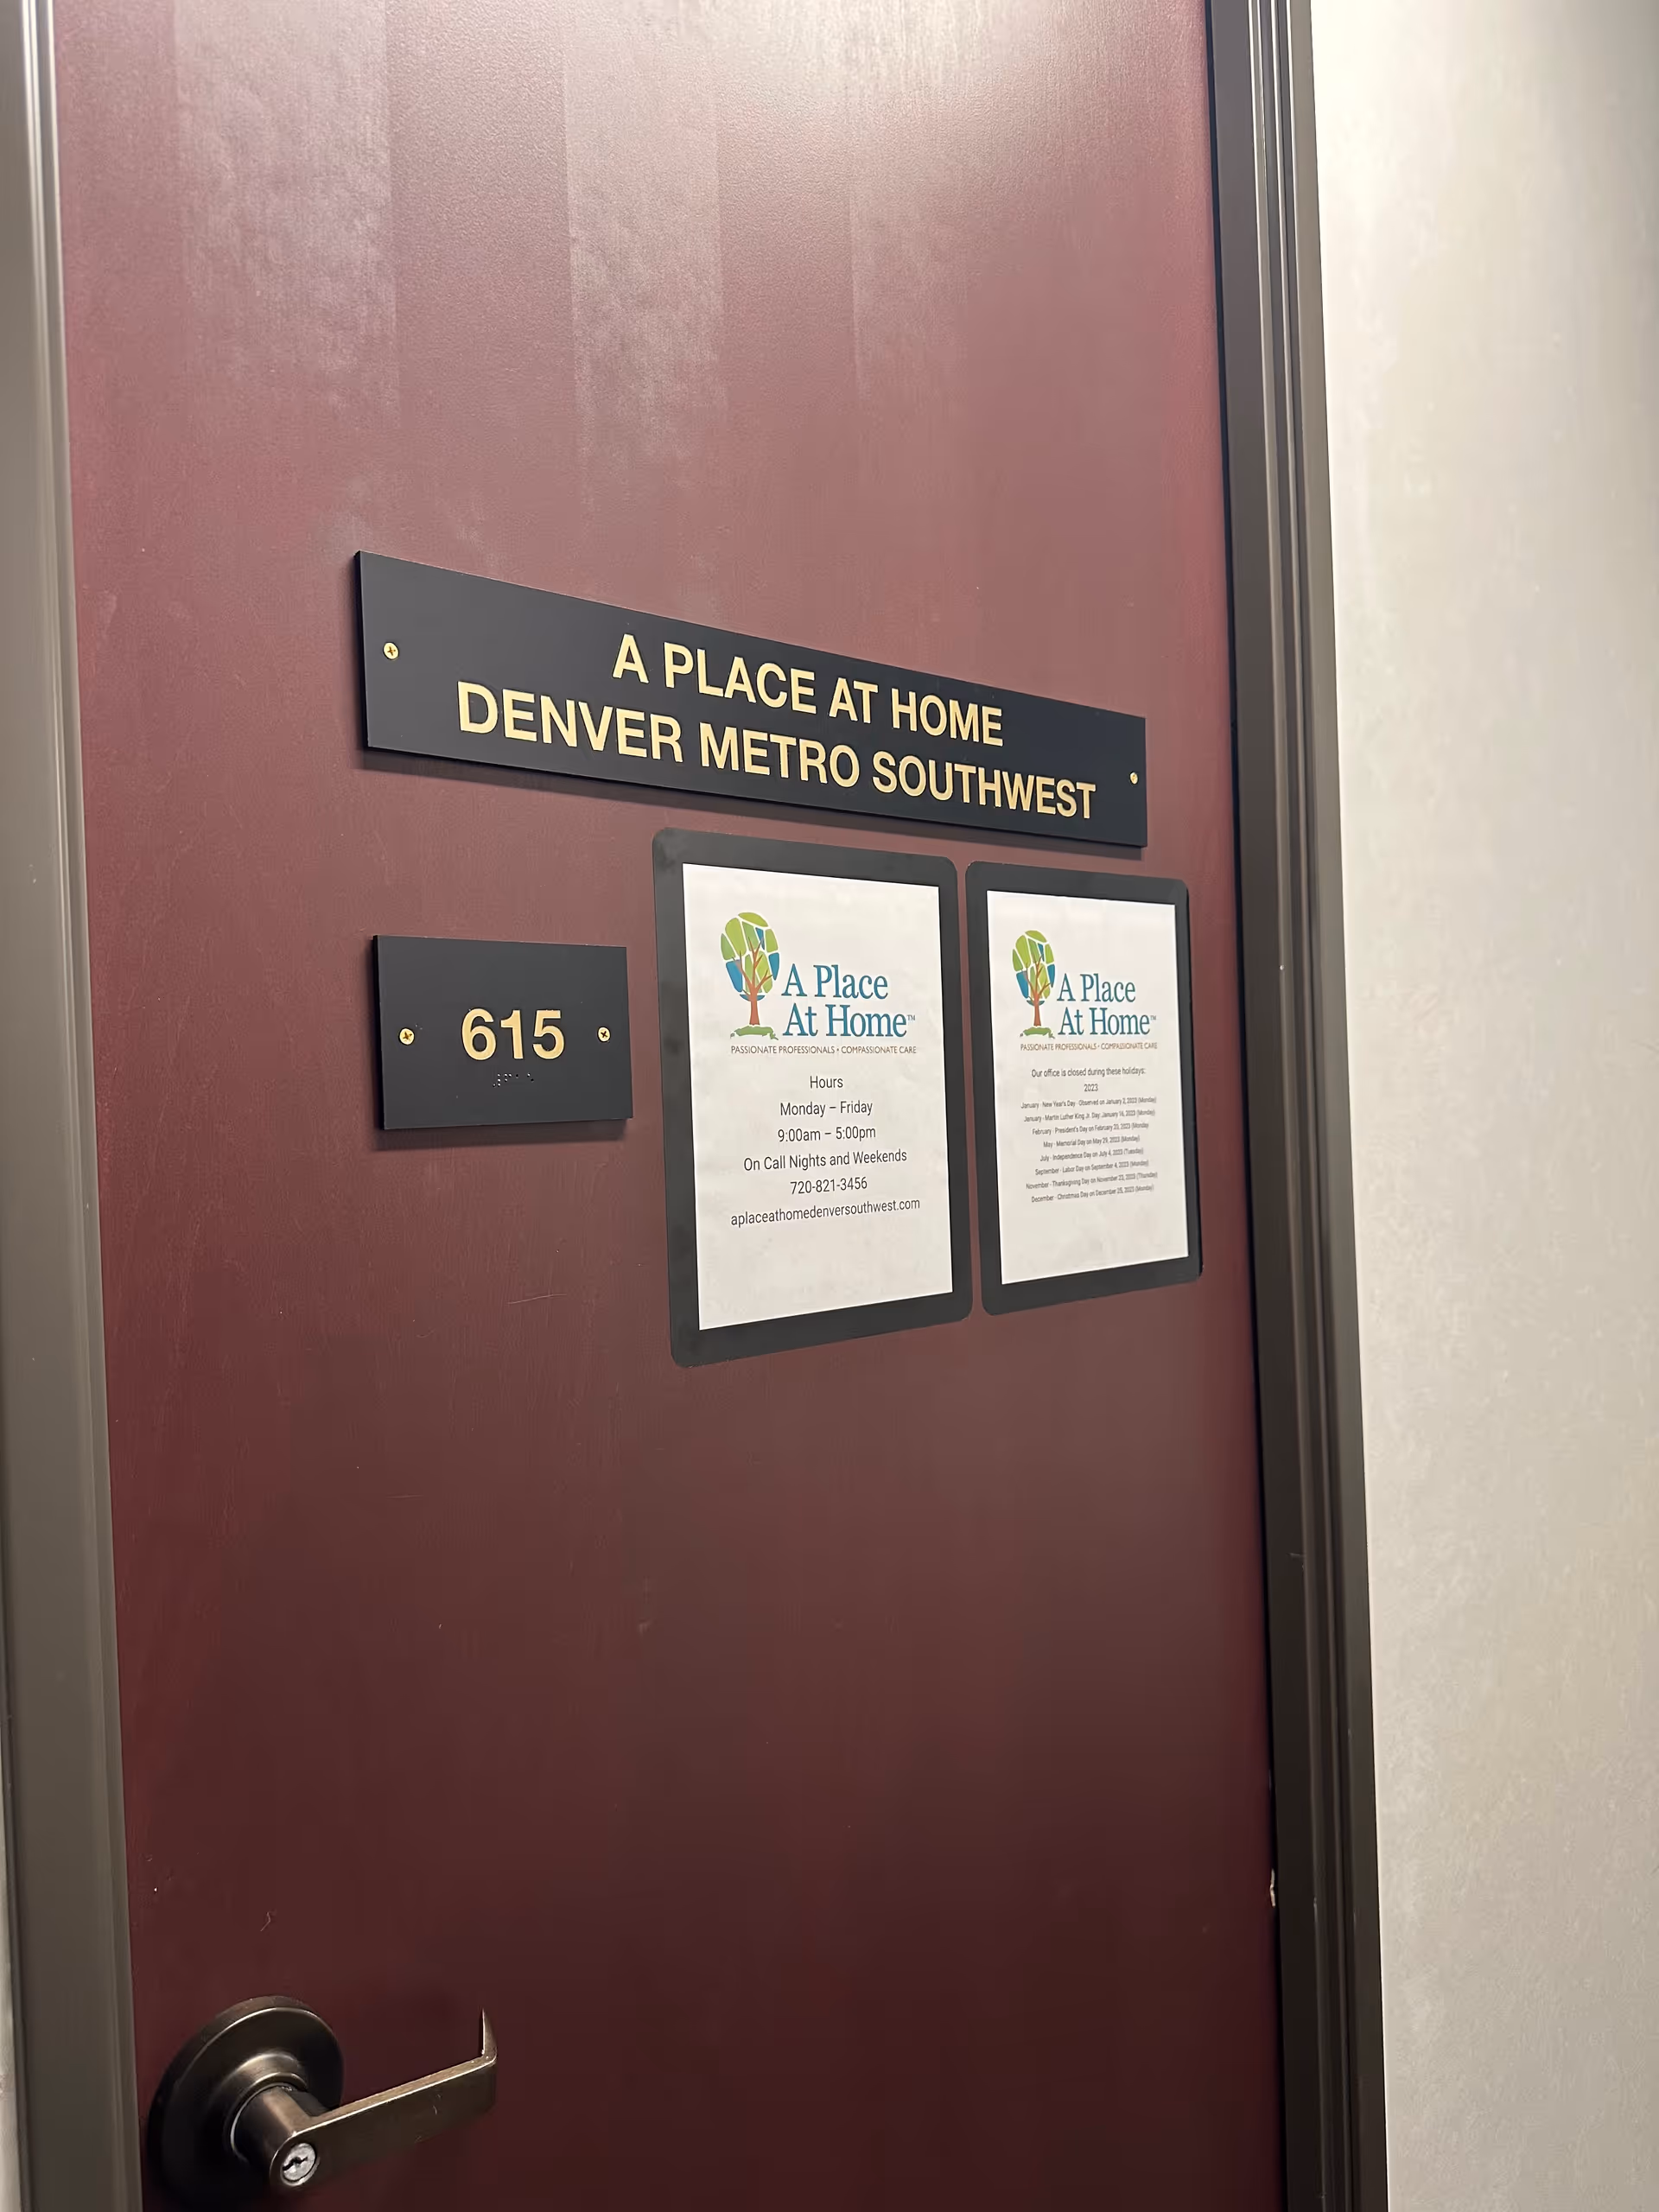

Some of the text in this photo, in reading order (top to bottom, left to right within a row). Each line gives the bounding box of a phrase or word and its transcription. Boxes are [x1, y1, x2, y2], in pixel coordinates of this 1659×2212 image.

[613, 633, 1003, 747] A PLACE AT HOME
[457, 681, 1096, 819] DENVER METRO SOUTHWEST
[781, 963, 888, 999] A Place
[1057, 973, 1136, 1002] A Place
[782, 1002, 818, 1037] At
[1058, 1007, 1084, 1035] At
[461, 1008, 565, 1061] 615
[731, 1046, 777, 1054] PASSIONATE
[779, 1046, 835, 1054] PROFESSIONALS
[841, 1046, 898, 1054] COMPASSIONATE
[899, 1046, 917, 1054] CARE
[810, 1075, 843, 1089] Hours
[1031, 1067, 1146, 1077] Our office is closed during these holidays:
[1084, 1084, 1098, 1092] 2023
[780, 1101, 825, 1117] Monday
[840, 1100, 873, 1116] Friday
[778, 1128, 821, 1142] 9:00am
[836, 1126, 876, 1141] 5:00pm
[744, 1148, 907, 1171] On Call Nights and Weekends
[1052, 1153, 1083, 1161] Independence
[790, 1176, 868, 1194] 720-821-3456
[1052, 1179, 1081, 1187] Thanksgiving
[731, 1198, 920, 1228] aplaceathomedenversouthwest.com
